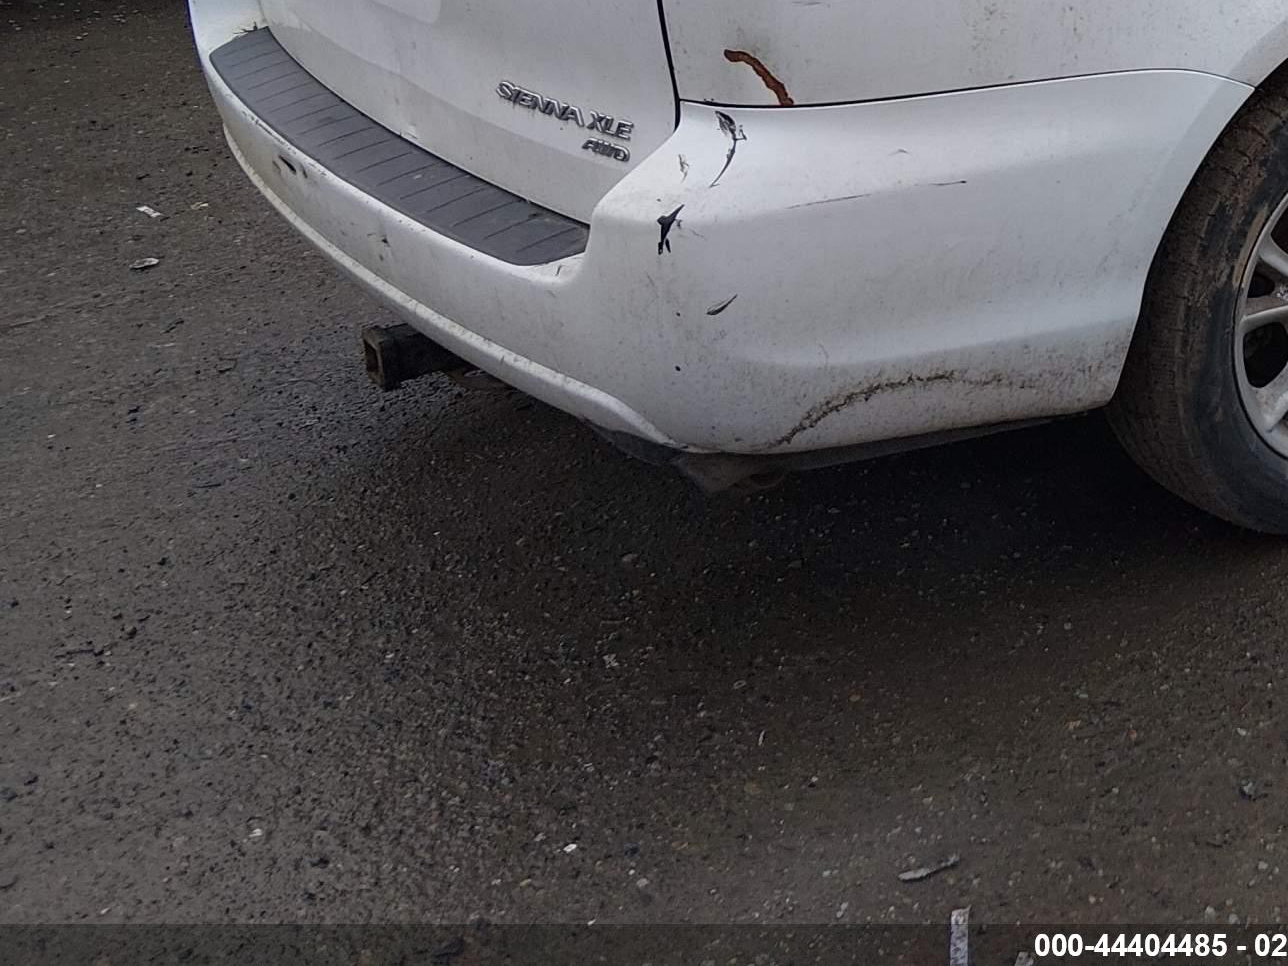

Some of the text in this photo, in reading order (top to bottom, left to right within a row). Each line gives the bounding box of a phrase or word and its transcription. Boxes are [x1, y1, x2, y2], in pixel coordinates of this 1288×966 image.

[496, 80, 634, 140] SIENNA XLE
[581, 137, 631, 163] AWD
